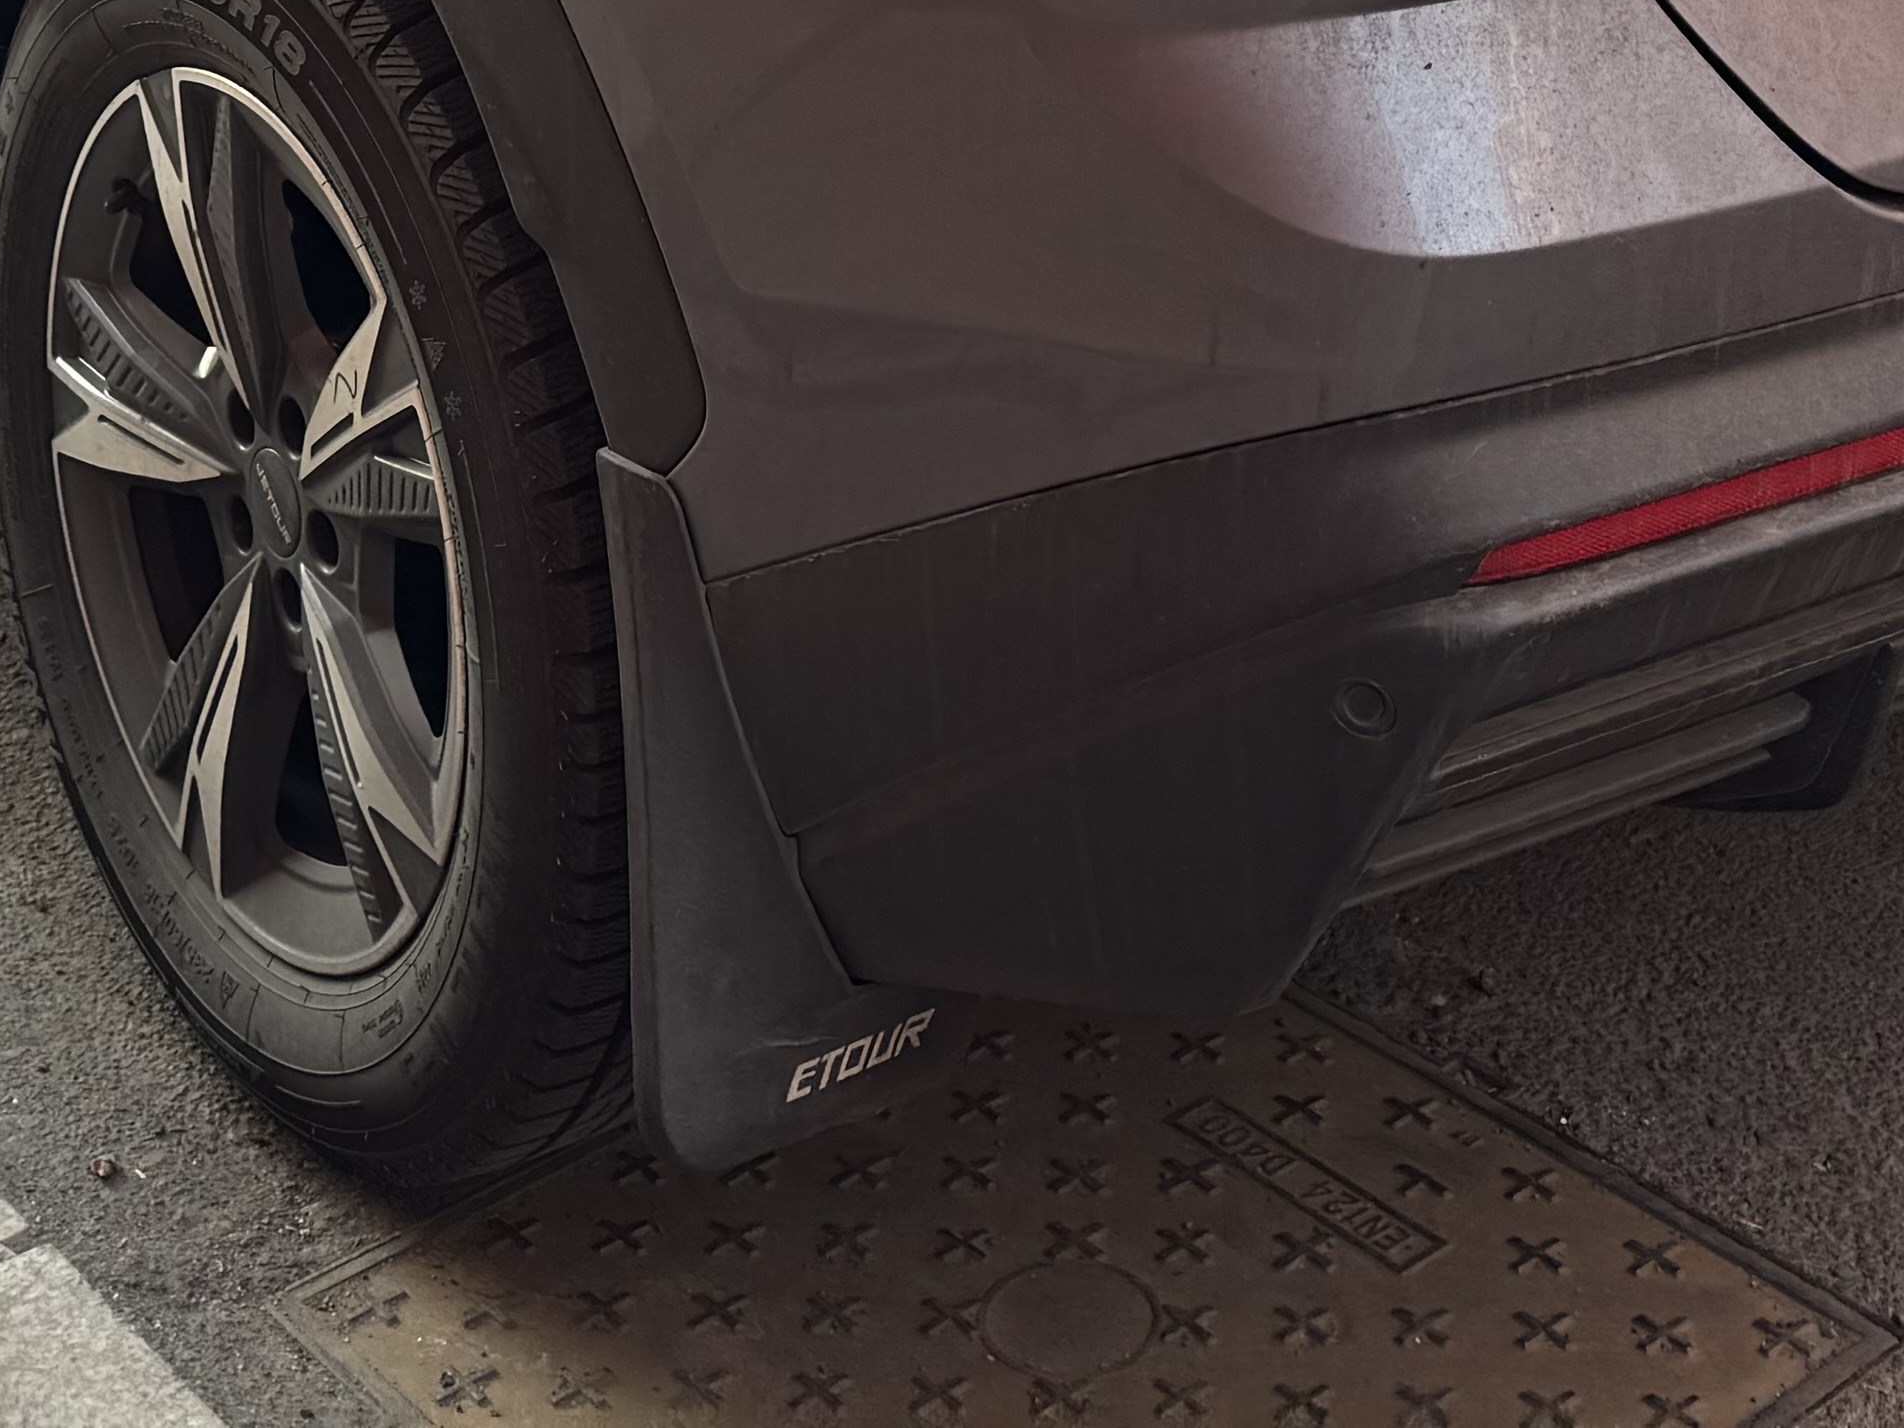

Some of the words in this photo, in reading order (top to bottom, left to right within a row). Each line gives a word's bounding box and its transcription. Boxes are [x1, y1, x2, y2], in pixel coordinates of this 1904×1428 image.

[255, 462, 292, 545] JETOUR
[786, 1008, 935, 1103] ETOUR
[1301, 1180, 1412, 1252] EN124
